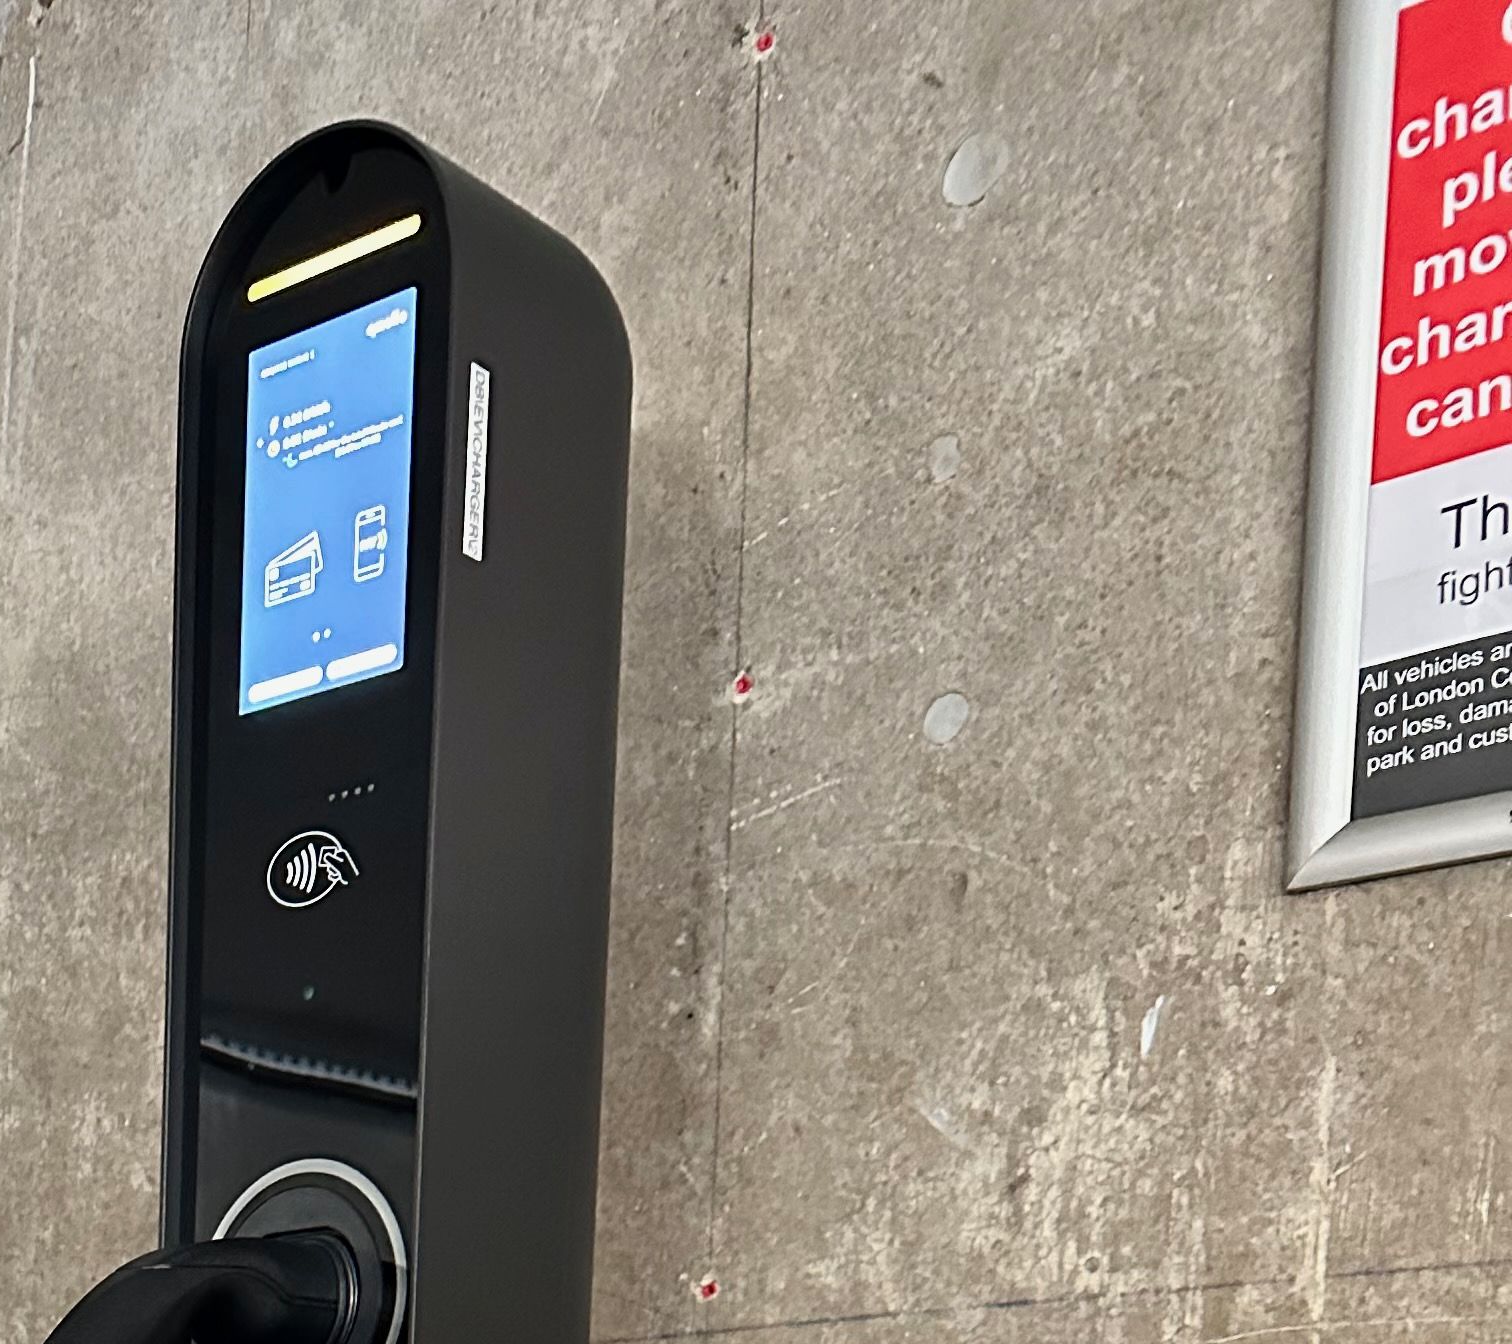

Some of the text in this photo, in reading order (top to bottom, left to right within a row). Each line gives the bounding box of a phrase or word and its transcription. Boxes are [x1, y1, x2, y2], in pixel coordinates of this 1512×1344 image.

[1397, 84, 1512, 159] cha
[1413, 229, 1512, 297] mo
[1380, 301, 1512, 376] char
[1406, 374, 1512, 438] can
[1440, 493, 1509, 549] Th
[1360, 669, 1389, 695] All
[1394, 650, 1484, 686] vehicles
[1374, 693, 1398, 717] of
[1402, 677, 1485, 711] London
[1367, 725, 1398, 747] for
[1402, 714, 1452, 738] loss,
[1367, 746, 1415, 778] park
[1420, 732, 1463, 761] and
